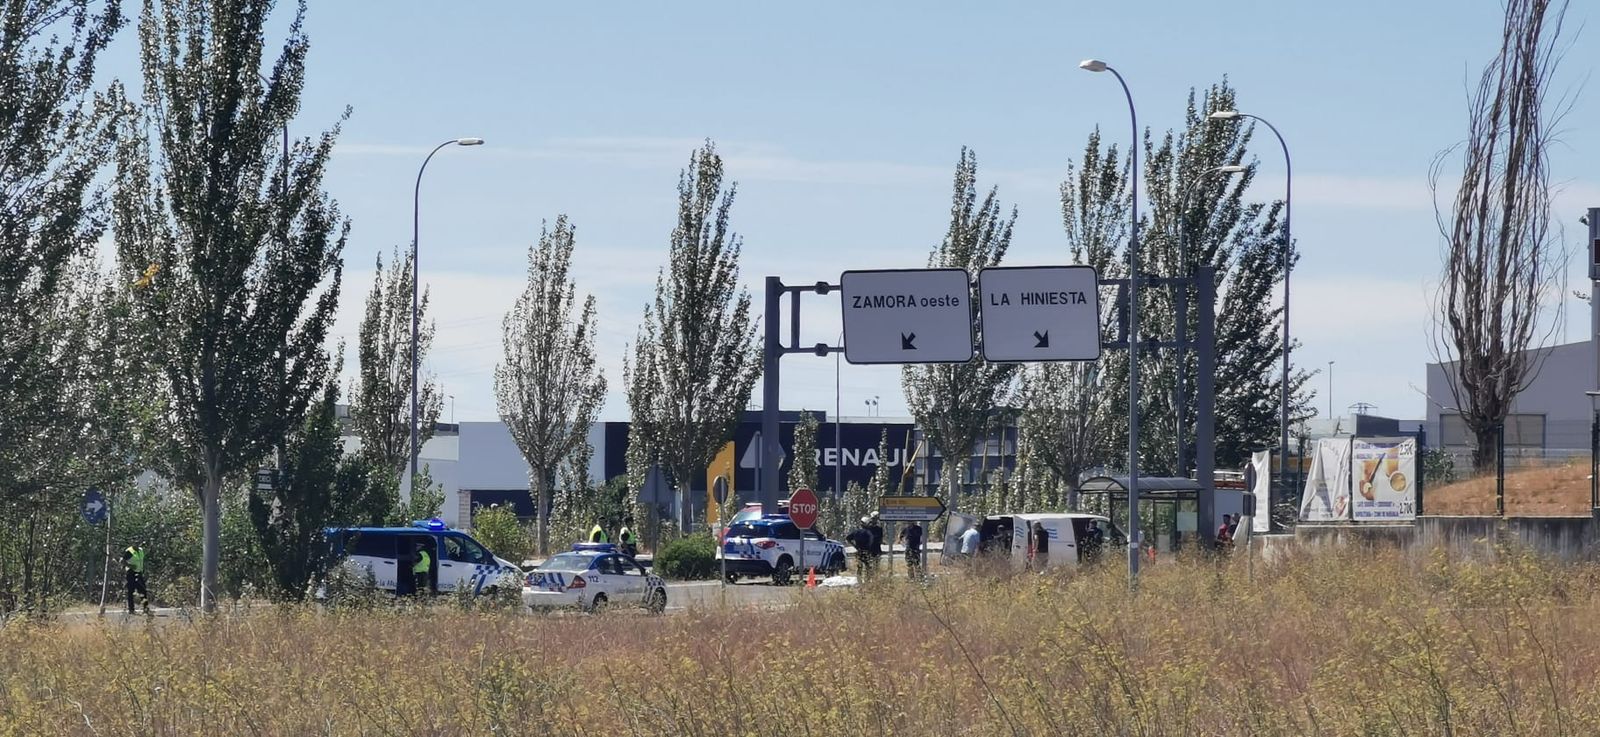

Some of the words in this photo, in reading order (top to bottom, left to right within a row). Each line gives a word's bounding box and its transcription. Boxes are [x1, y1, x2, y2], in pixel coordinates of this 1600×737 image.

[853, 295, 917, 309] ZAMORA
[920, 294, 960, 307] oeste
[990, 292, 1010, 306] LA
[1021, 291, 1088, 305] HINIESTA
[791, 503, 817, 515] STOP
[588, 575, 600, 584] 112
